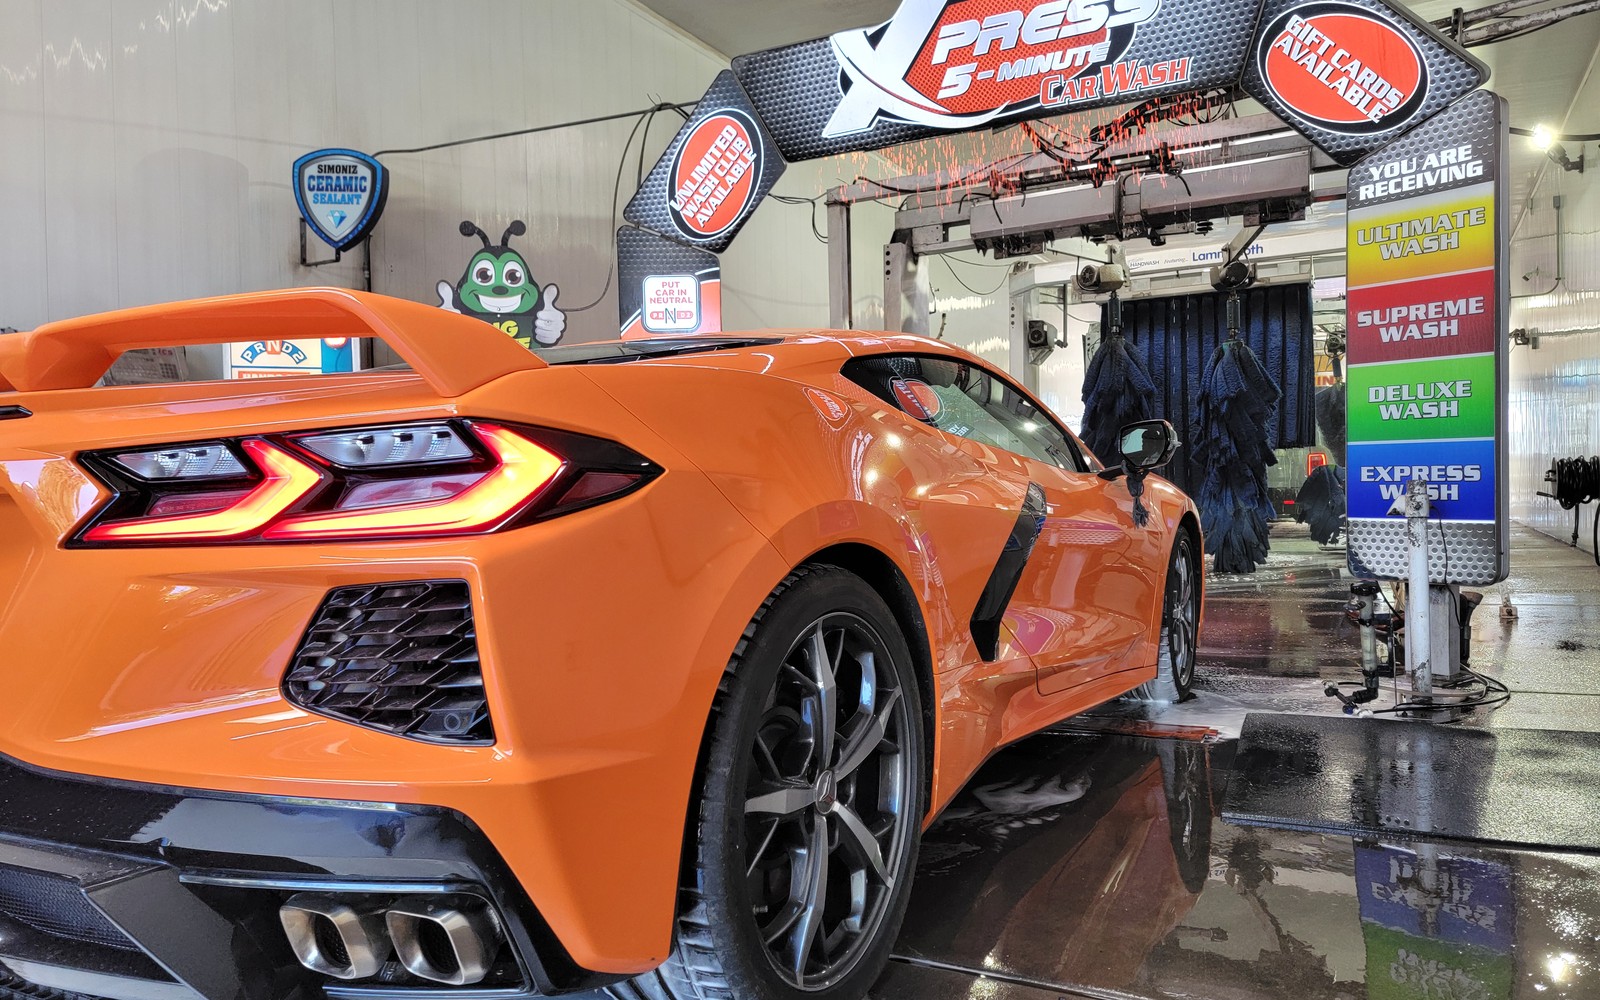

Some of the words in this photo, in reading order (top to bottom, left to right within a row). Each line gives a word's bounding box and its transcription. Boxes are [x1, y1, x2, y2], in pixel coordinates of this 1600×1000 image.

[1285, 14, 1335, 57] GIFT
[1330, 48, 1404, 109] CARDS
[1040, 77, 1098, 107] CAR
[1101, 57, 1192, 96] WASH
[1274, 34, 1388, 123] AVAILABLE
[317, 164, 358, 174] SIMONIZ
[669, 124, 737, 211] UNLIMITED
[682, 174, 720, 218] WASH
[714, 136, 747, 177] CLUB
[1369, 157, 1416, 181] YOU
[1422, 144, 1472, 170] ARE
[307, 175, 367, 192] CERAMIC
[696, 147, 757, 228] AVAILABLE
[1359, 160, 1483, 201] RECEIVING
[312, 193, 362, 205] SEALANT
[1357, 207, 1486, 246] ULTIMATE
[1379, 231, 1459, 260] WASH
[1357, 296, 1484, 327] SUPREME
[1379, 319, 1459, 343] WASH
[1368, 380, 1472, 403] DELUXE
[1379, 400, 1459, 420] WASH
[1360, 465, 1481, 482] EXPRESS
[1379, 484, 1459, 501] WSH
